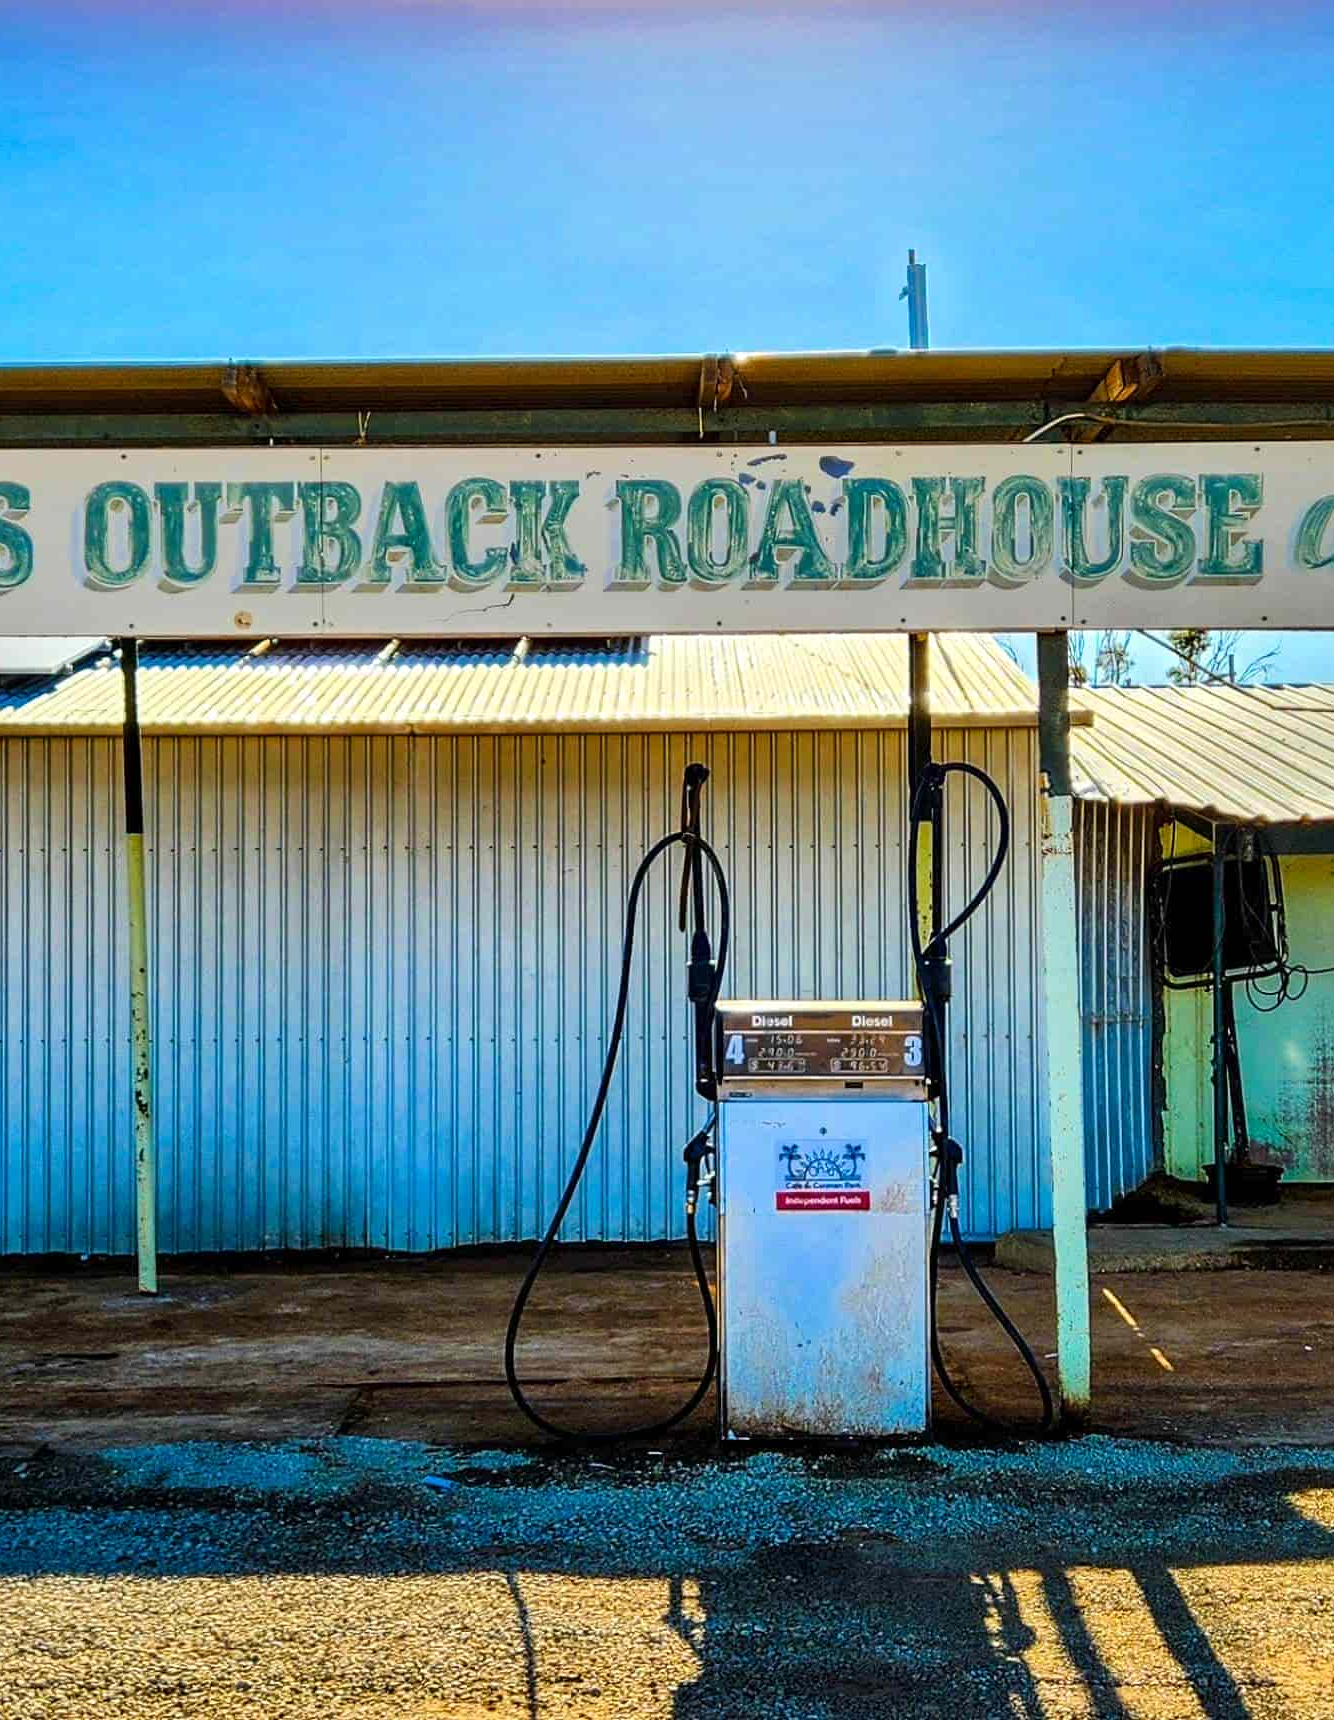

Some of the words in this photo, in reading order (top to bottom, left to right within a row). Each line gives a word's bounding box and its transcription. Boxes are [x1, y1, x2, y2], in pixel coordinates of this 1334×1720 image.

[80, 478, 589, 590] OUTBACK
[607, 473, 1266, 590] ROADHOUSE
[751, 1015, 793, 1028] Diesel
[852, 1015, 893, 1028] Diesel
[725, 1034, 746, 1065] 4
[903, 1035, 924, 1067] 3
